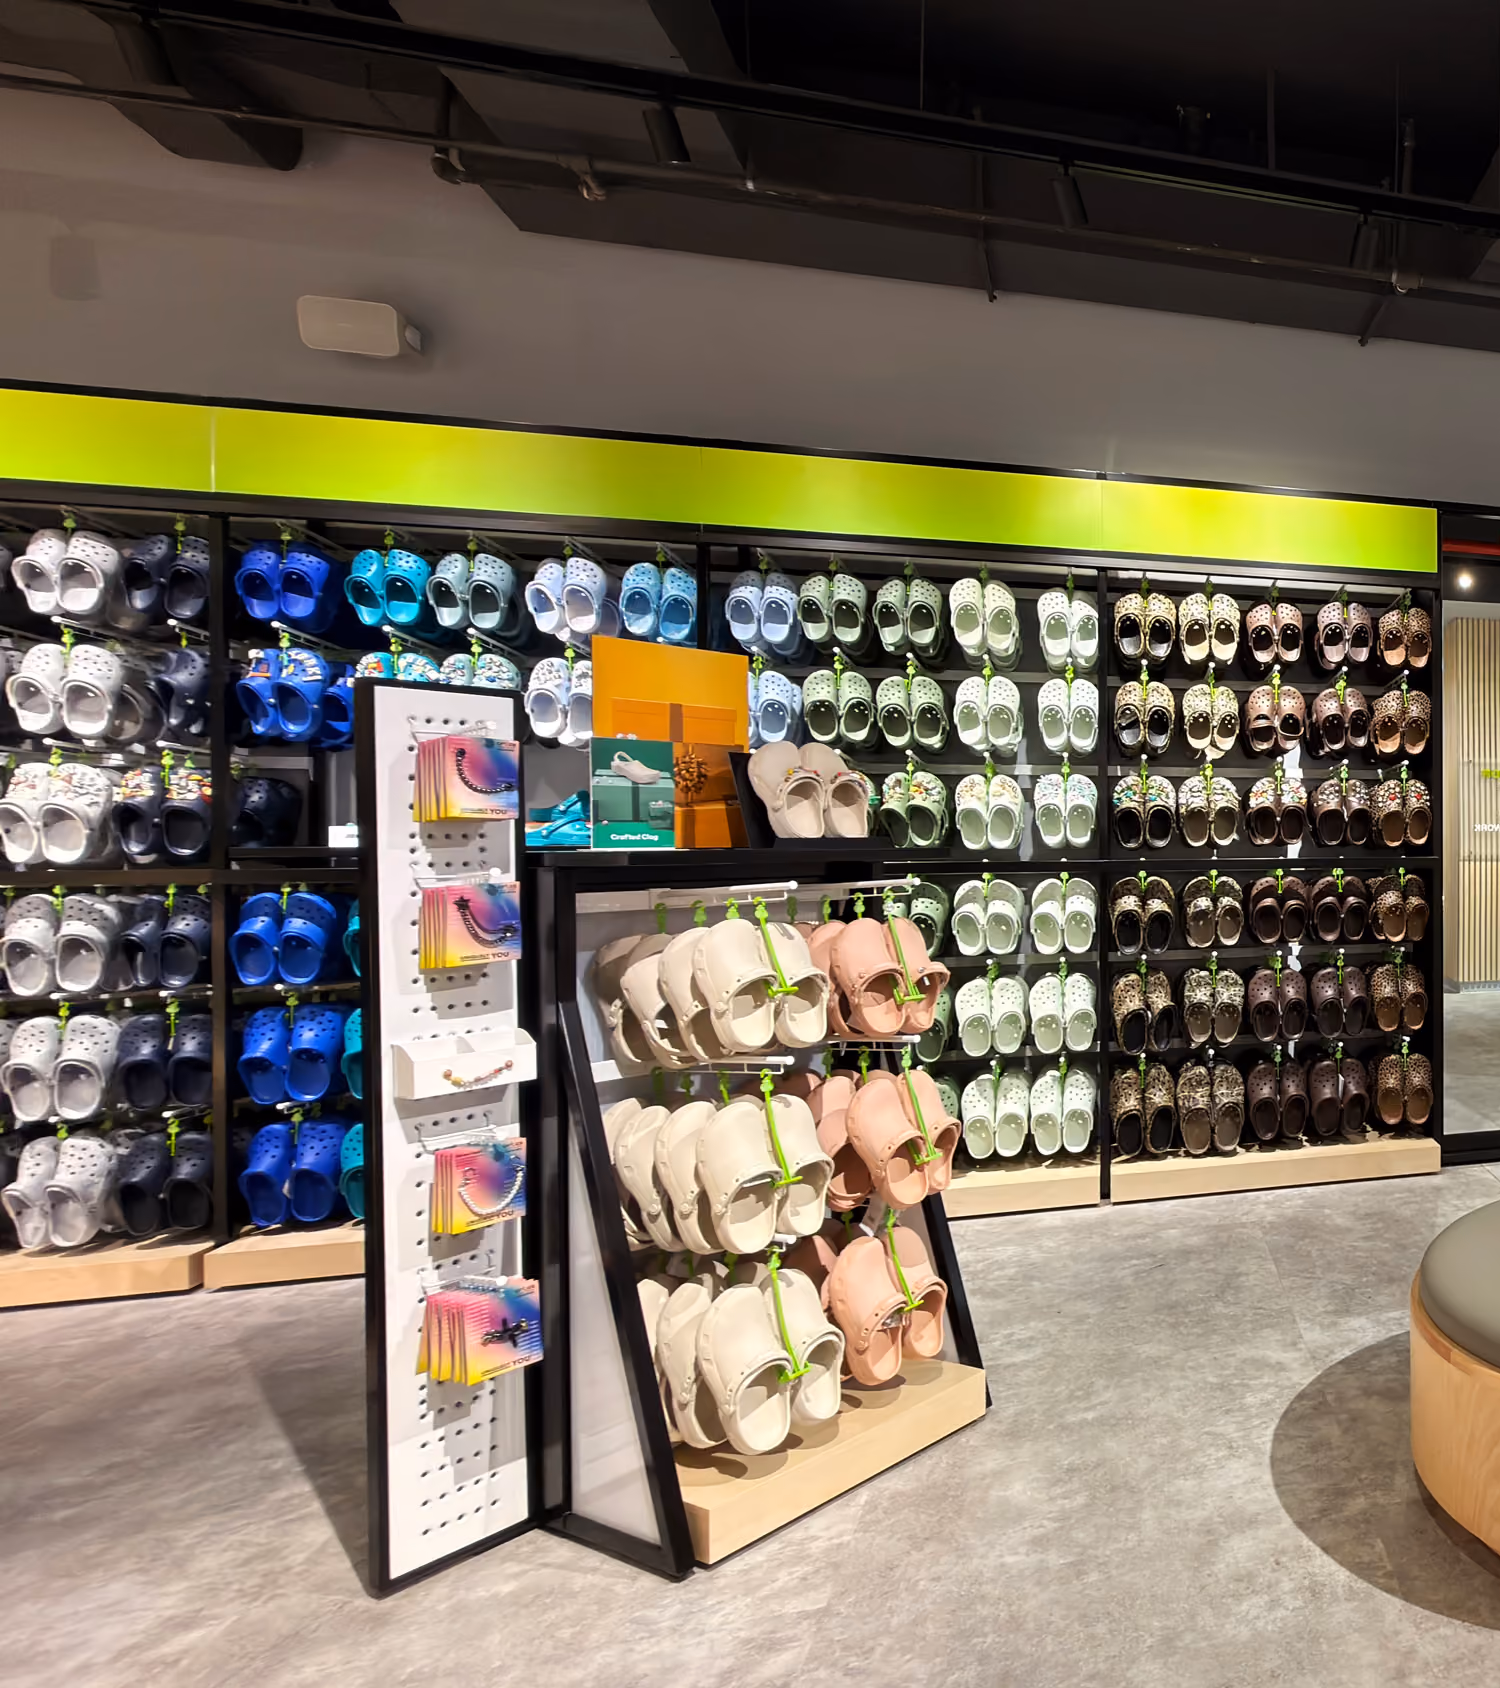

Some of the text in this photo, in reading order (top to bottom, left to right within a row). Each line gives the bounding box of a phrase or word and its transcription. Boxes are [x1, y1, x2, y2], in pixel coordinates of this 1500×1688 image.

[610, 833, 659, 842] Crafted Clog
[491, 951, 510, 959] YOU
